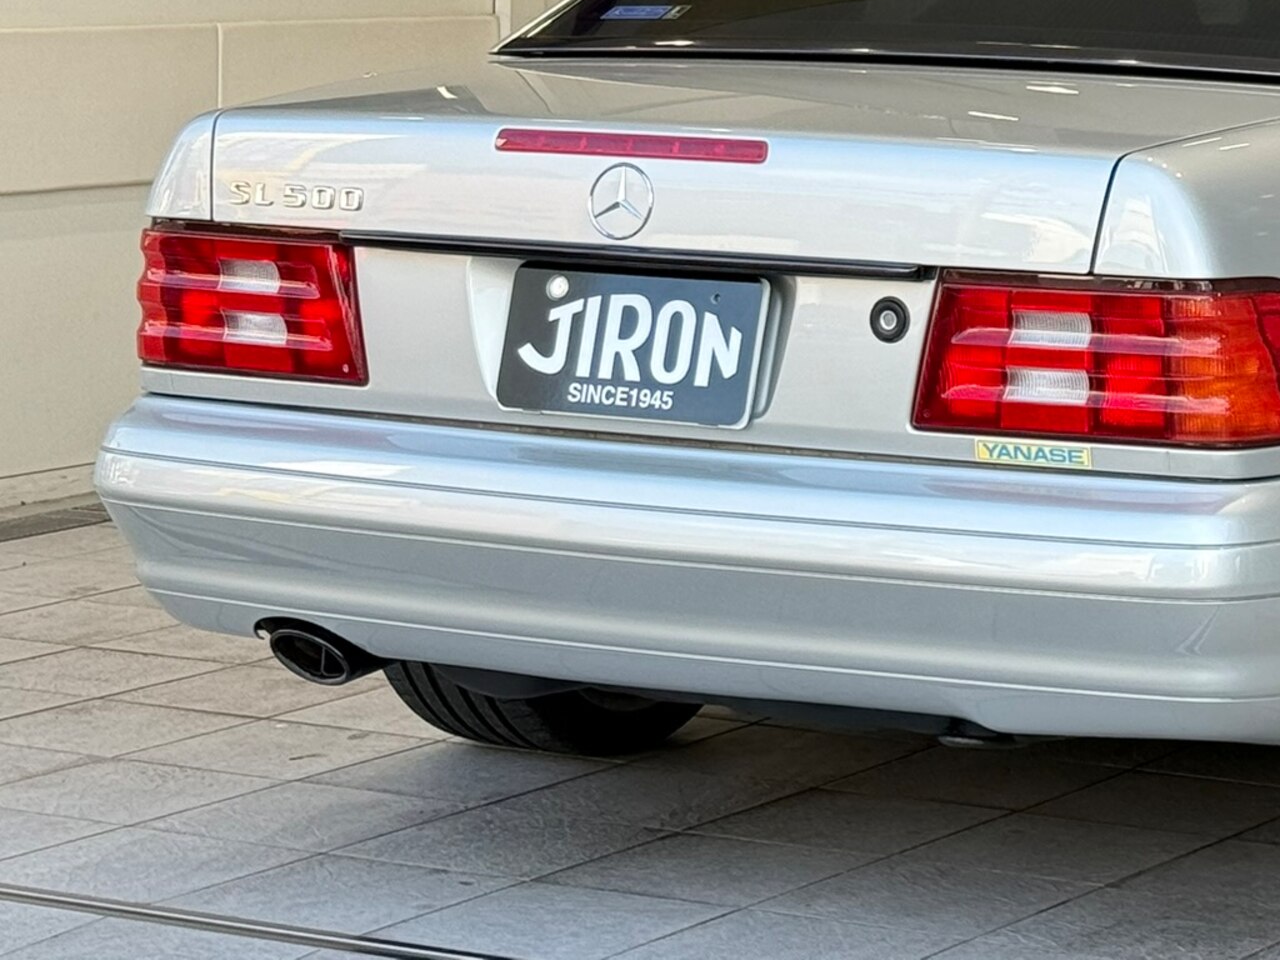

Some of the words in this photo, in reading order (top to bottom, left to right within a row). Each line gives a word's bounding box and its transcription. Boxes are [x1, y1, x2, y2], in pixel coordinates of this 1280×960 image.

[229, 181, 274, 206] SL
[283, 183, 364, 211] 500
[517, 294, 742, 387] JIRON
[567, 383, 674, 410] SINCE1945
[981, 442, 1085, 465] YANASE
